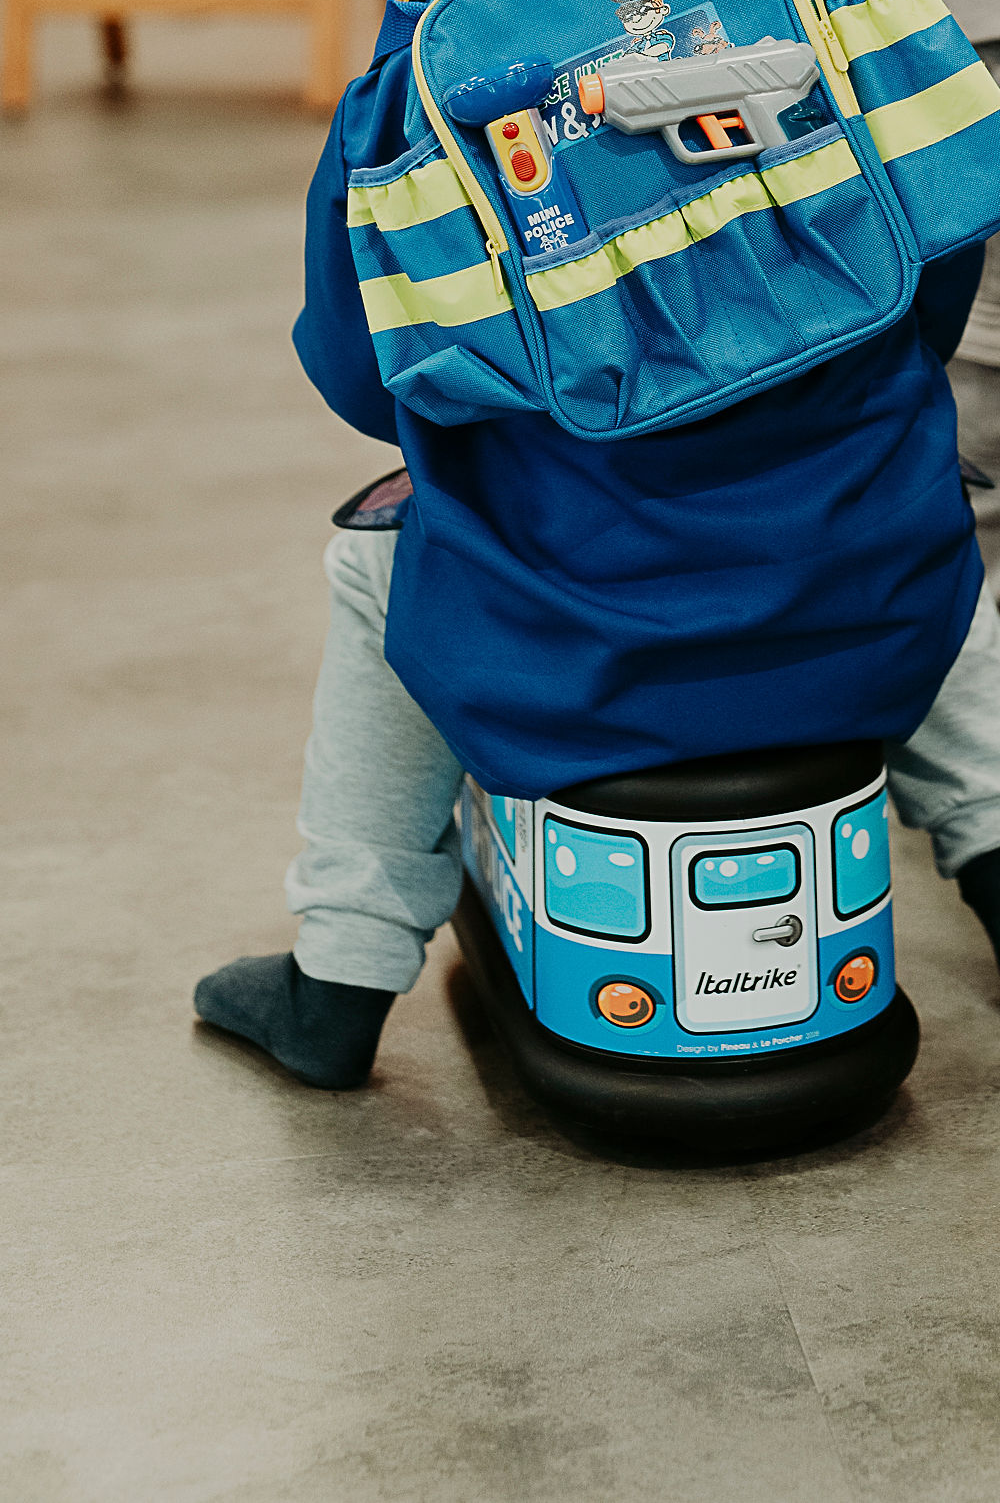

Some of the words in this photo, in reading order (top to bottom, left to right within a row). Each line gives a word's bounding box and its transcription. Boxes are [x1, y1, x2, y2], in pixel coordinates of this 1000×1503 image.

[524, 213, 575, 242] POLICE
[527, 204, 561, 227] MINI
[695, 967, 797, 995] Italtrike
[676, 1044, 706, 1054] Design
[707, 1044, 719, 1053] by
[720, 1043, 750, 1051] Pineau
[751, 1041, 759, 1049] &
[760, 1039, 771, 1047] Le
